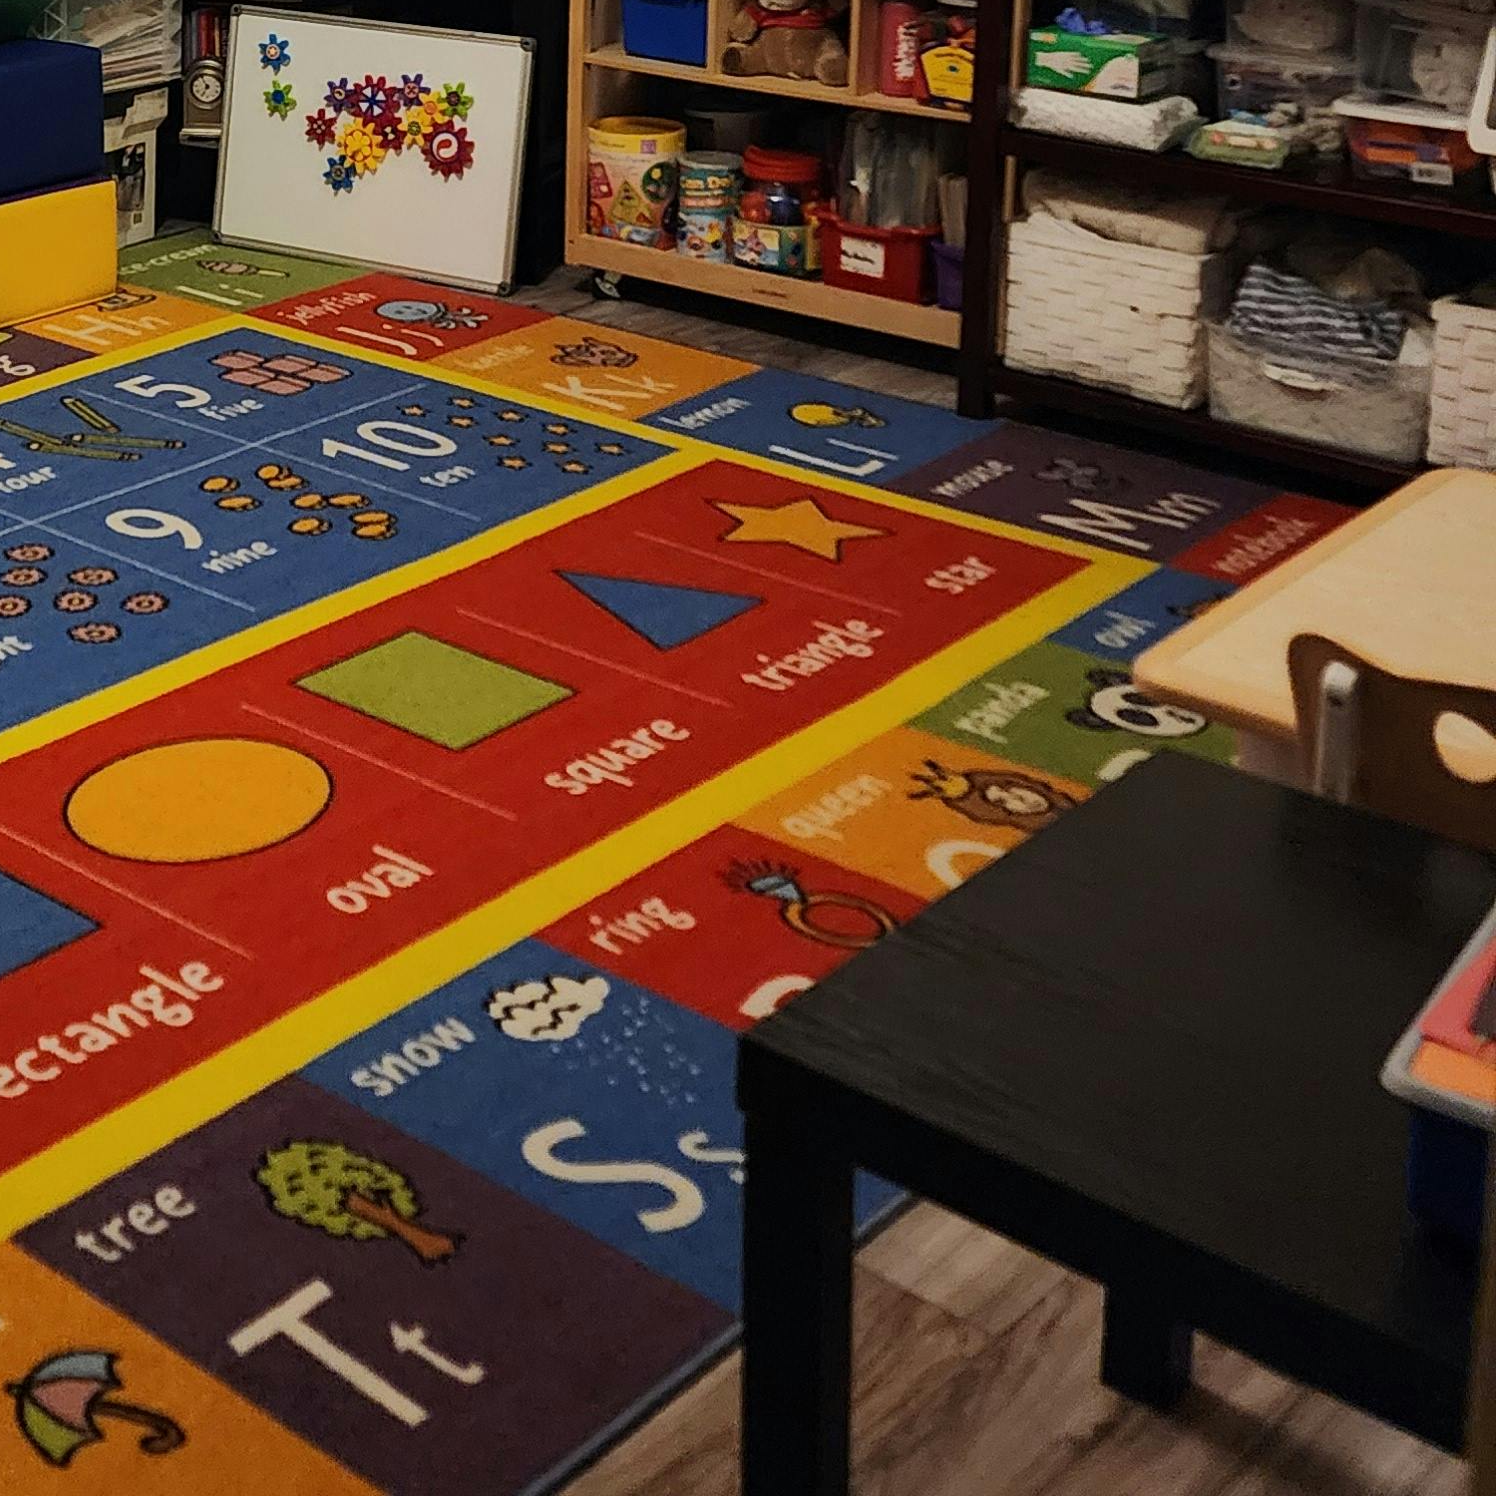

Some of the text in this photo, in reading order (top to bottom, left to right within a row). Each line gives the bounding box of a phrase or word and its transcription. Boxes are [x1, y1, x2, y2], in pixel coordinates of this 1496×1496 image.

[114, 375, 213, 410] 5
[196, 396, 266, 423] five
[541, 374, 678, 412] Kk
[321, 419, 459, 471] 10
[418, 462, 477, 490] ten
[104, 508, 204, 550] 9
[1036, 491, 1222, 551] Mm
[201, 537, 280, 577] nine
[922, 554, 998, 596] star
[739, 615, 886, 692] triangle
[543, 717, 692, 797] square
[325, 843, 435, 916] oval
[587, 894, 697, 957] ring
[349, 1013, 478, 1097] snow
[73, 1179, 200, 1265] tree
[226, 1276, 488, 1429] Tt
